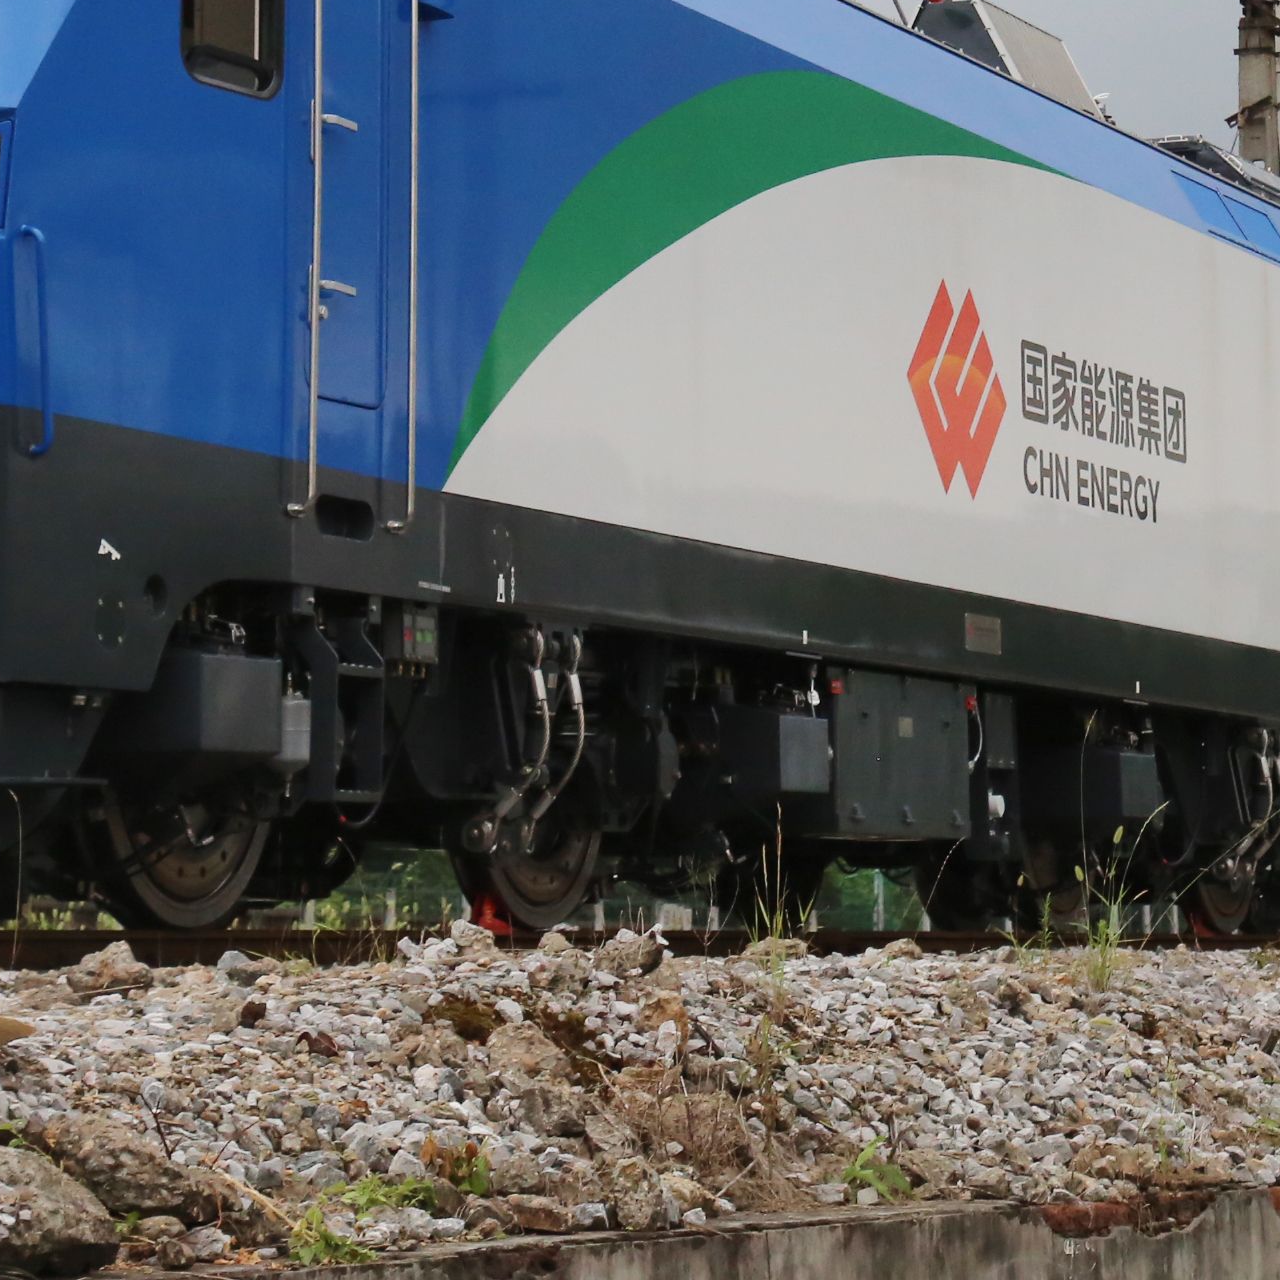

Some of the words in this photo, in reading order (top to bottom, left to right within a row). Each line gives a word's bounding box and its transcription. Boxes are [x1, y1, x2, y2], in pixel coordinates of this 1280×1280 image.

[1021, 339, 1187, 464] 国家能源集团
[1023, 446, 1070, 501] CHN
[1076, 459, 1160, 523] ENERGY
